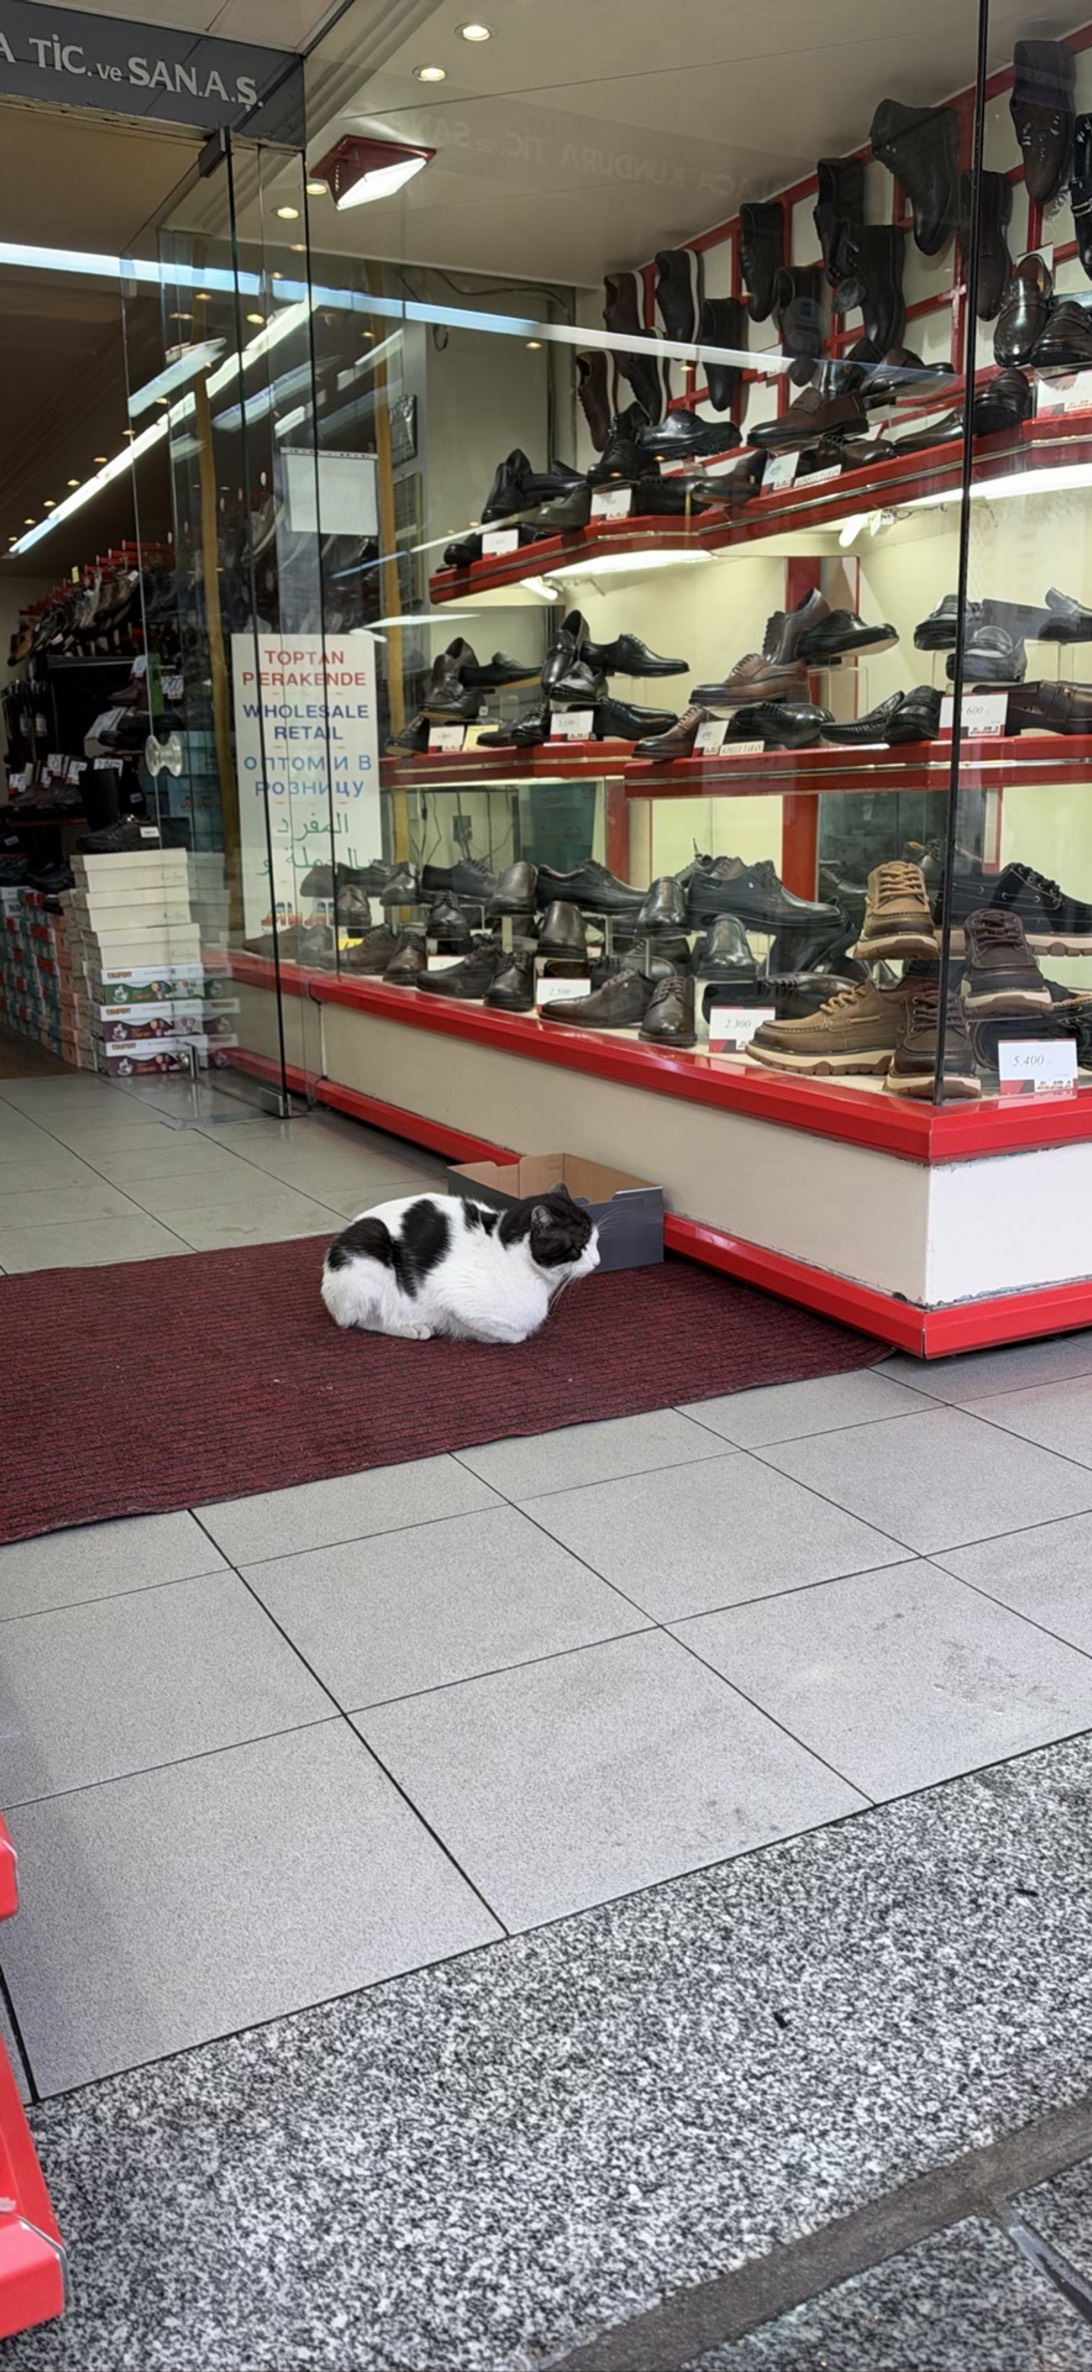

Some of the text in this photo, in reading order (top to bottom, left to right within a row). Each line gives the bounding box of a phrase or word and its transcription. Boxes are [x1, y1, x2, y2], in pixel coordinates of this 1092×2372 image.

[28, 34, 93, 77] TİC.
[96, 63, 122, 82] ve
[264, 650, 344, 666] TOPTAN
[242, 671, 366, 686] PERAKENDE
[243, 704, 369, 719] WHOLESALE
[274, 726, 343, 740] RETAIL
[724, 1019, 752, 1029] 2.300
[1012, 1055, 1045, 1067] 5.400
